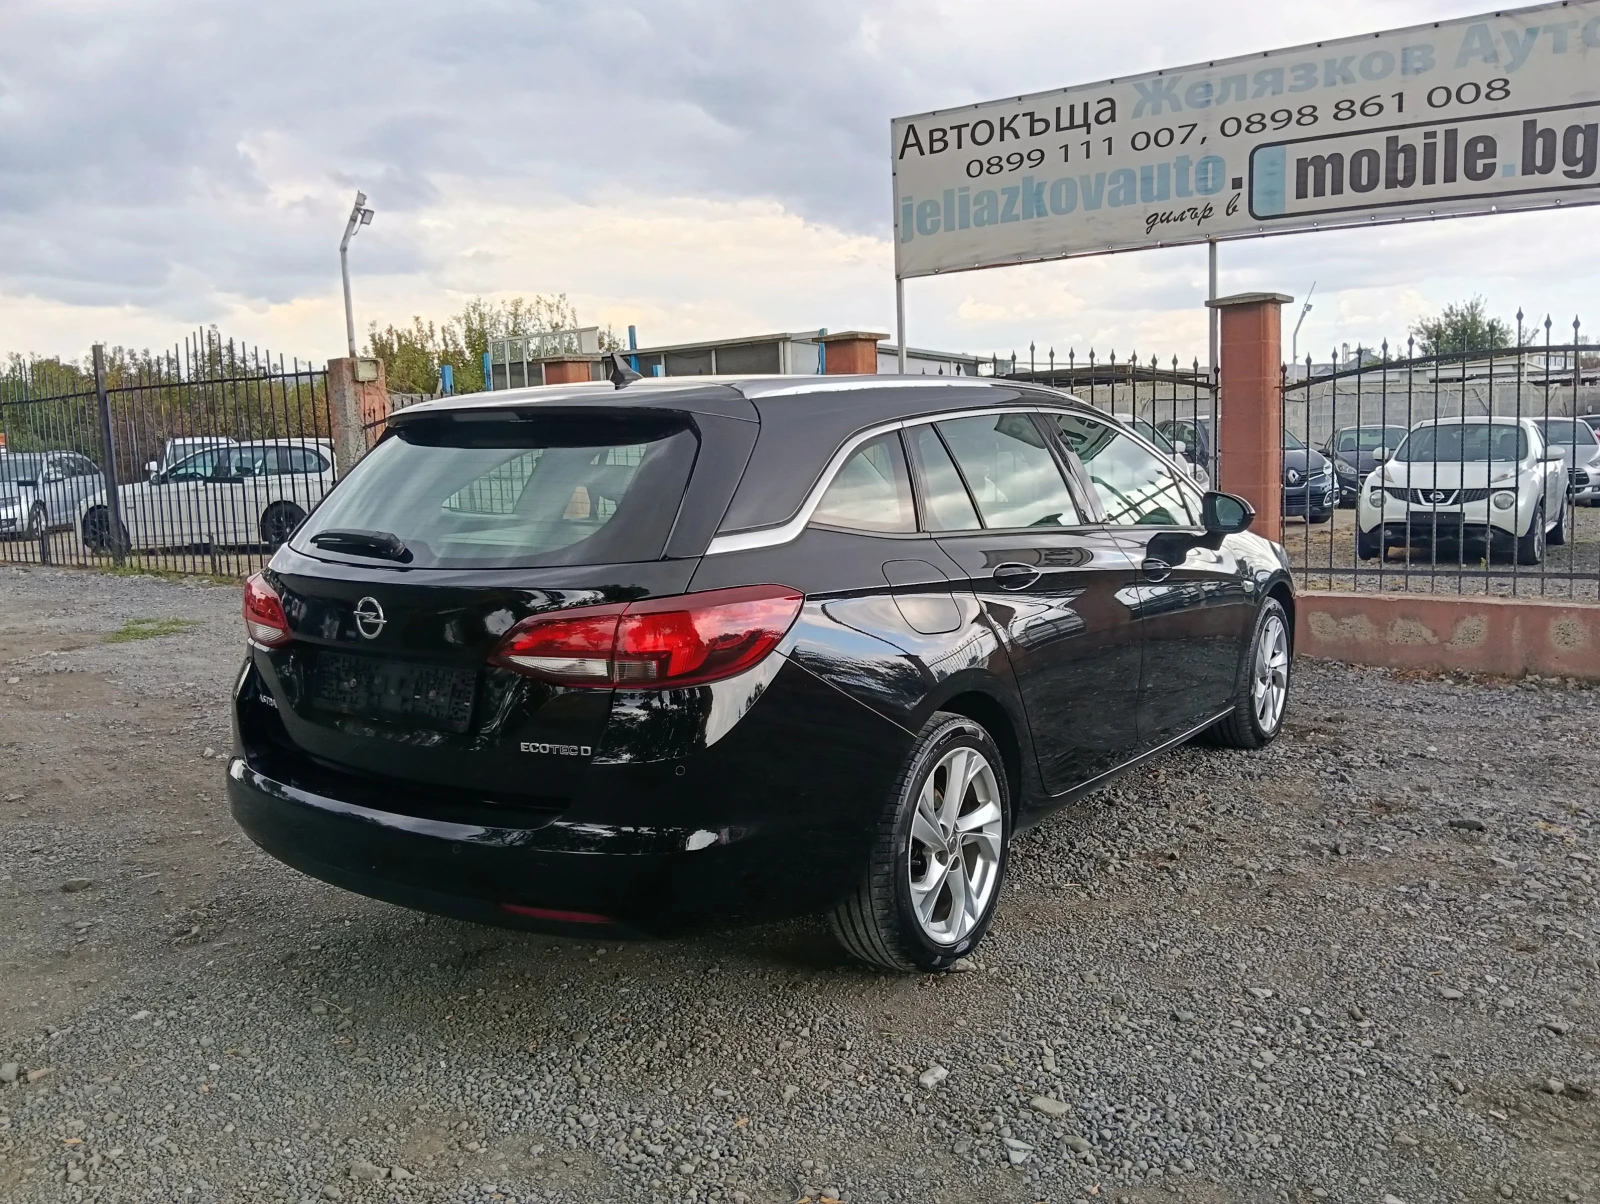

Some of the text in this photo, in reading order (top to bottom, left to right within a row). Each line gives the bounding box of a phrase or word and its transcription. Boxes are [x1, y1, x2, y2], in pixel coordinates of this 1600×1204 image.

[898, 97, 1116, 160] Автокъща
[1131, 46, 1436, 119] Желязков
[965, 77, 1511, 178] 0899 111 007, 0898 861 008
[1295, 118, 1599, 200] mobile.bg
[1145, 202, 1215, 235] дилър
[520, 742, 579, 756] ECOTEC
